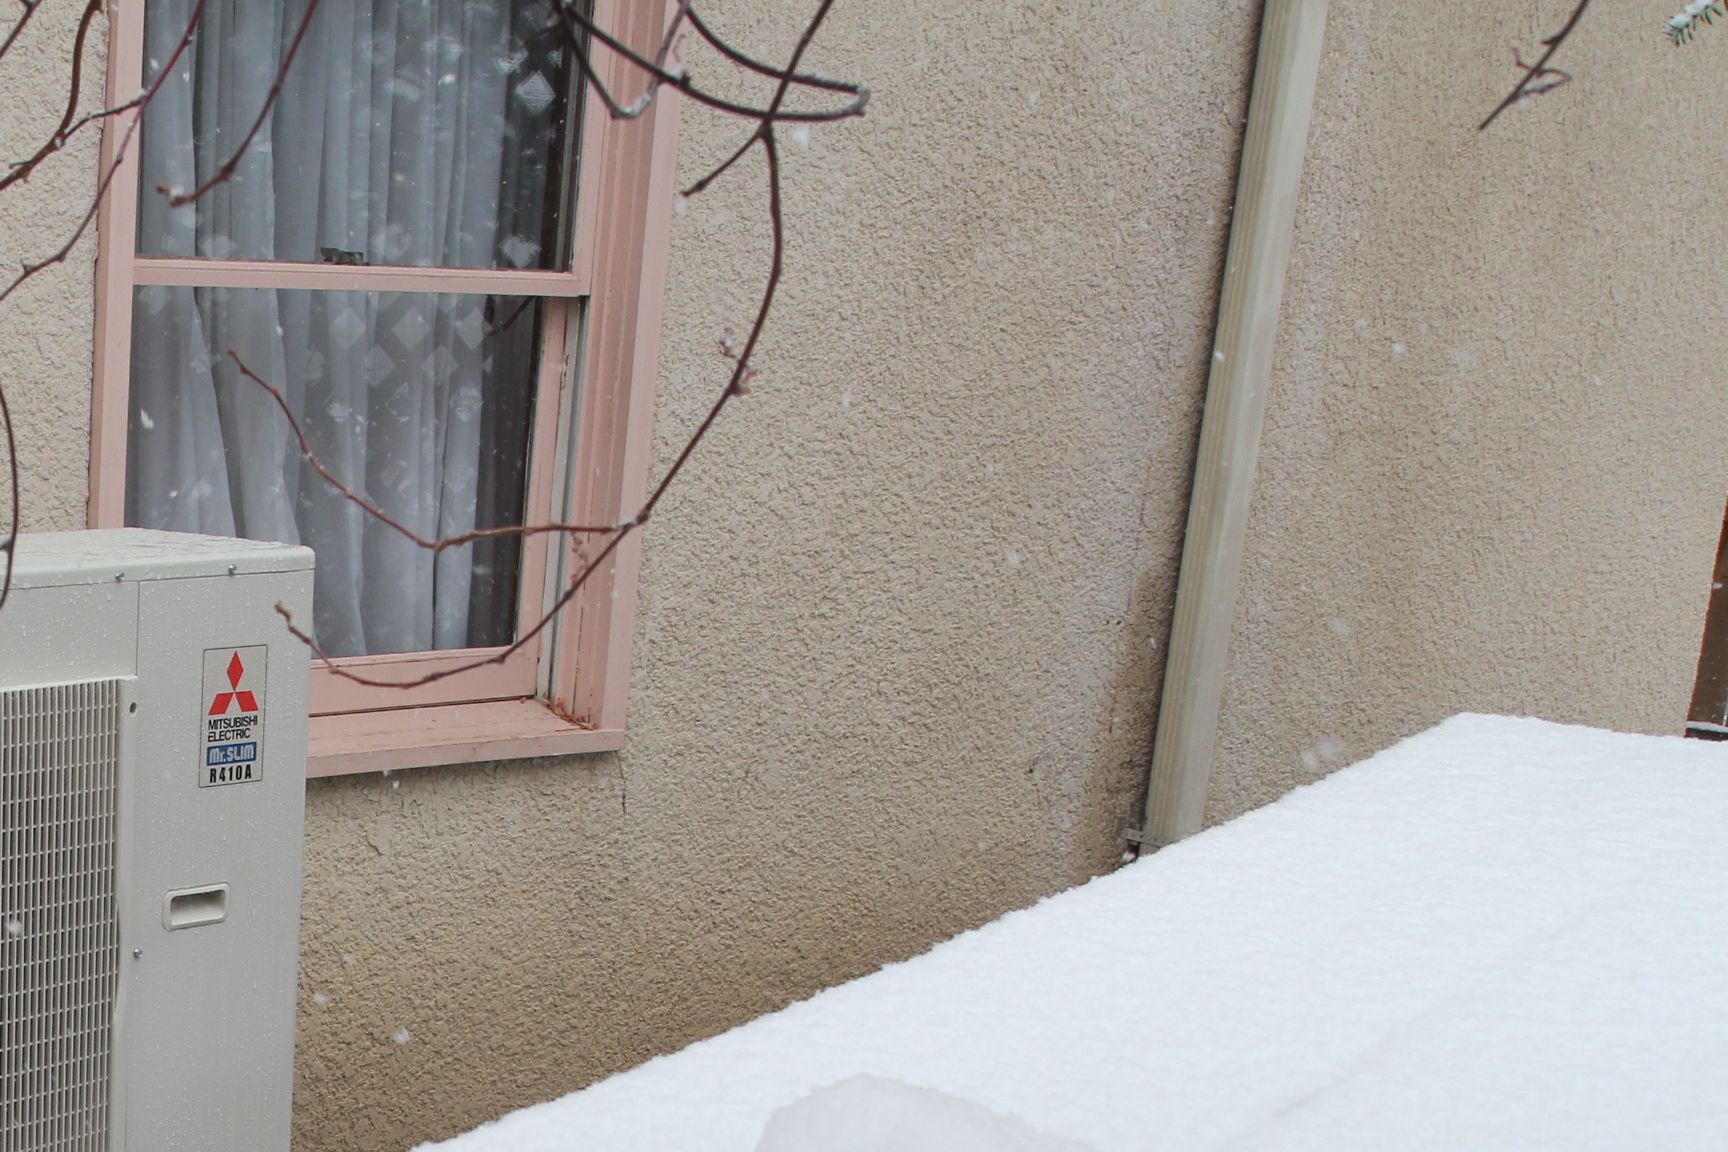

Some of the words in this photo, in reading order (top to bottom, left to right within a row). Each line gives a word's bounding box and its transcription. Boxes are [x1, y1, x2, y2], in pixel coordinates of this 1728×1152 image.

[208, 716, 258, 730] MITSUBISHI
[208, 728, 251, 742] ELECTRIC
[210, 764, 252, 784] R410A
